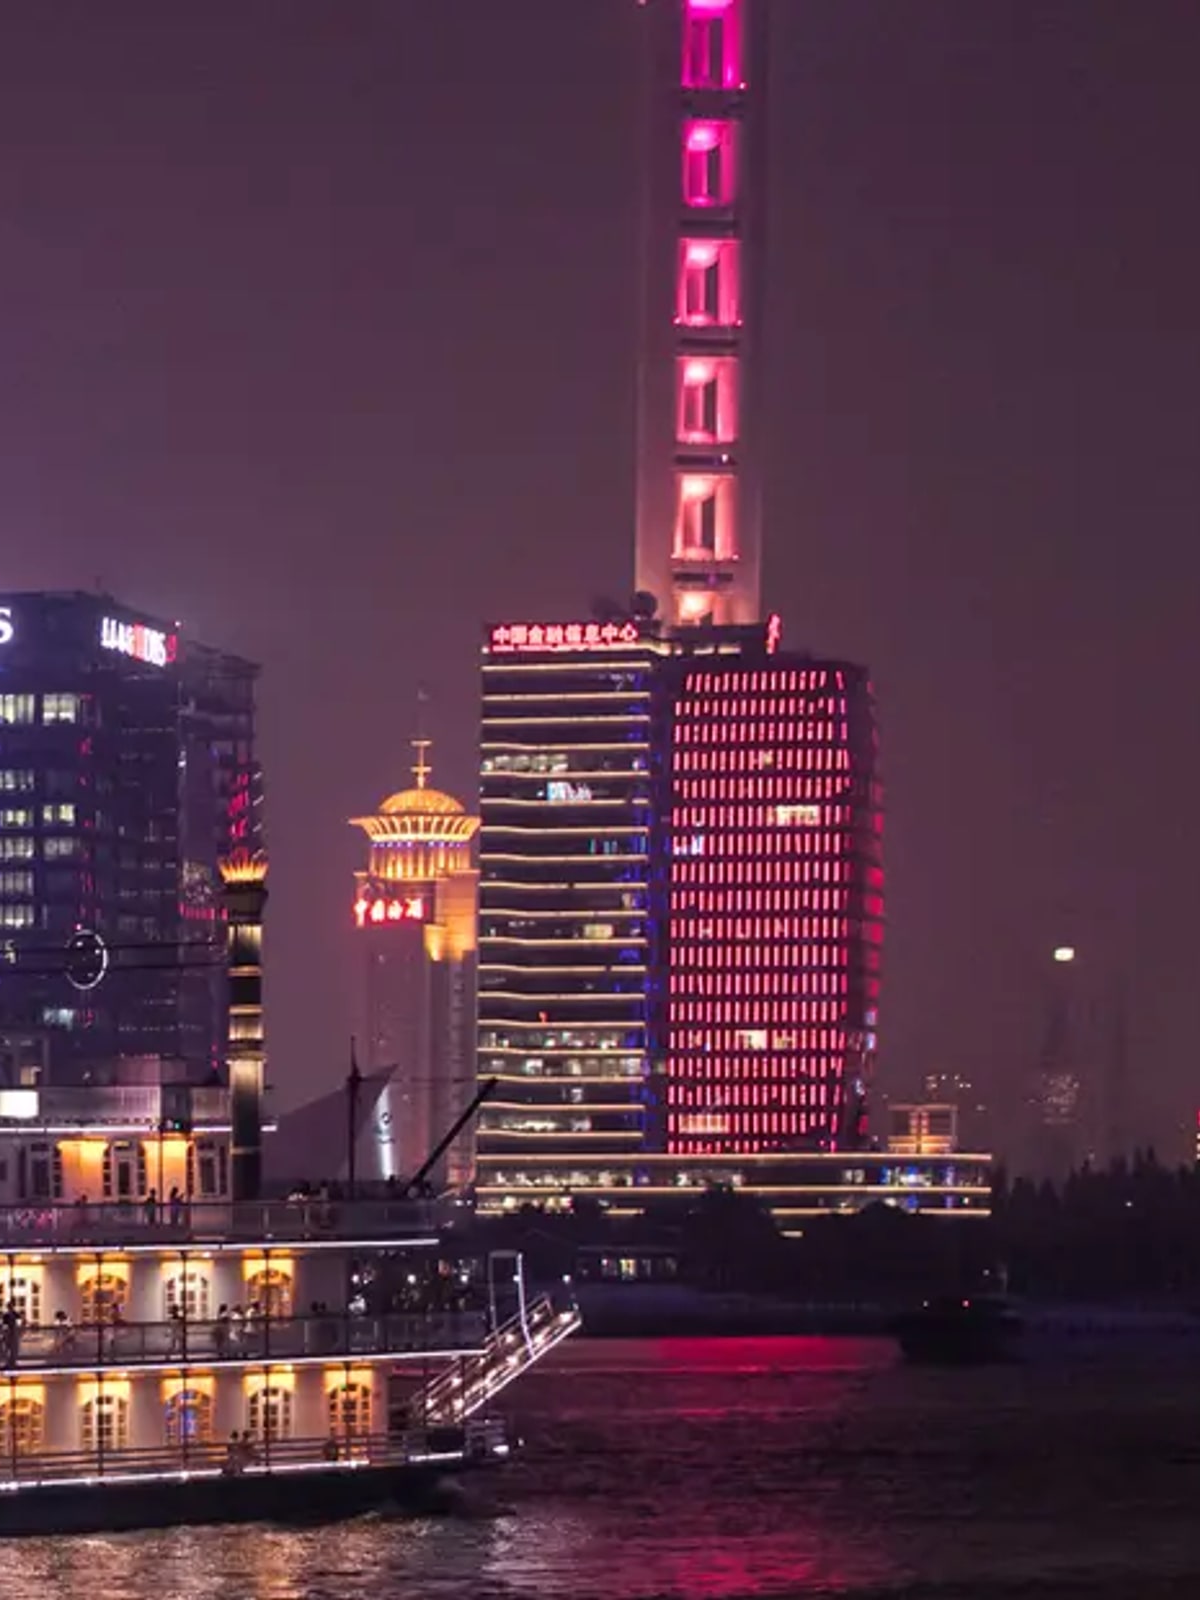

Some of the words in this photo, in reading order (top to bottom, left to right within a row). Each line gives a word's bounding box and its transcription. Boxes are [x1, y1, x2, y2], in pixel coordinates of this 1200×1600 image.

[492, 623, 638, 645] 中国金融信息中心
